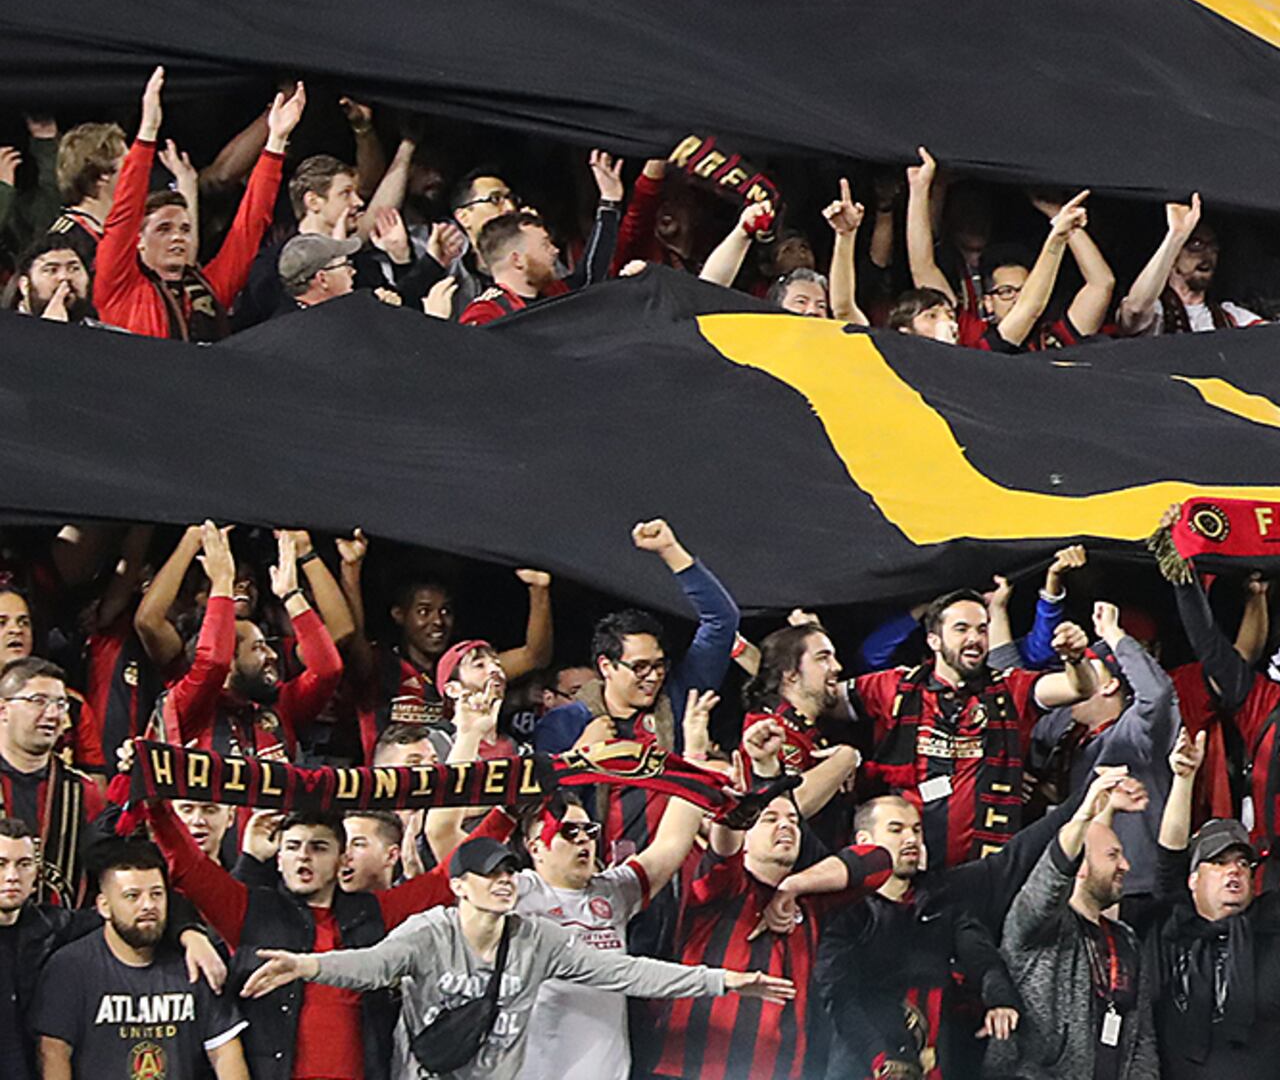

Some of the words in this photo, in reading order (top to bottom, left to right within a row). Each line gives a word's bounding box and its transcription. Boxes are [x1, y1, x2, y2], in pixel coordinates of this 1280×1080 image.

[150, 748, 284, 796] HAIL
[95, 993, 196, 1024] ATLANTA
[119, 1024, 178, 1039] UNITED
